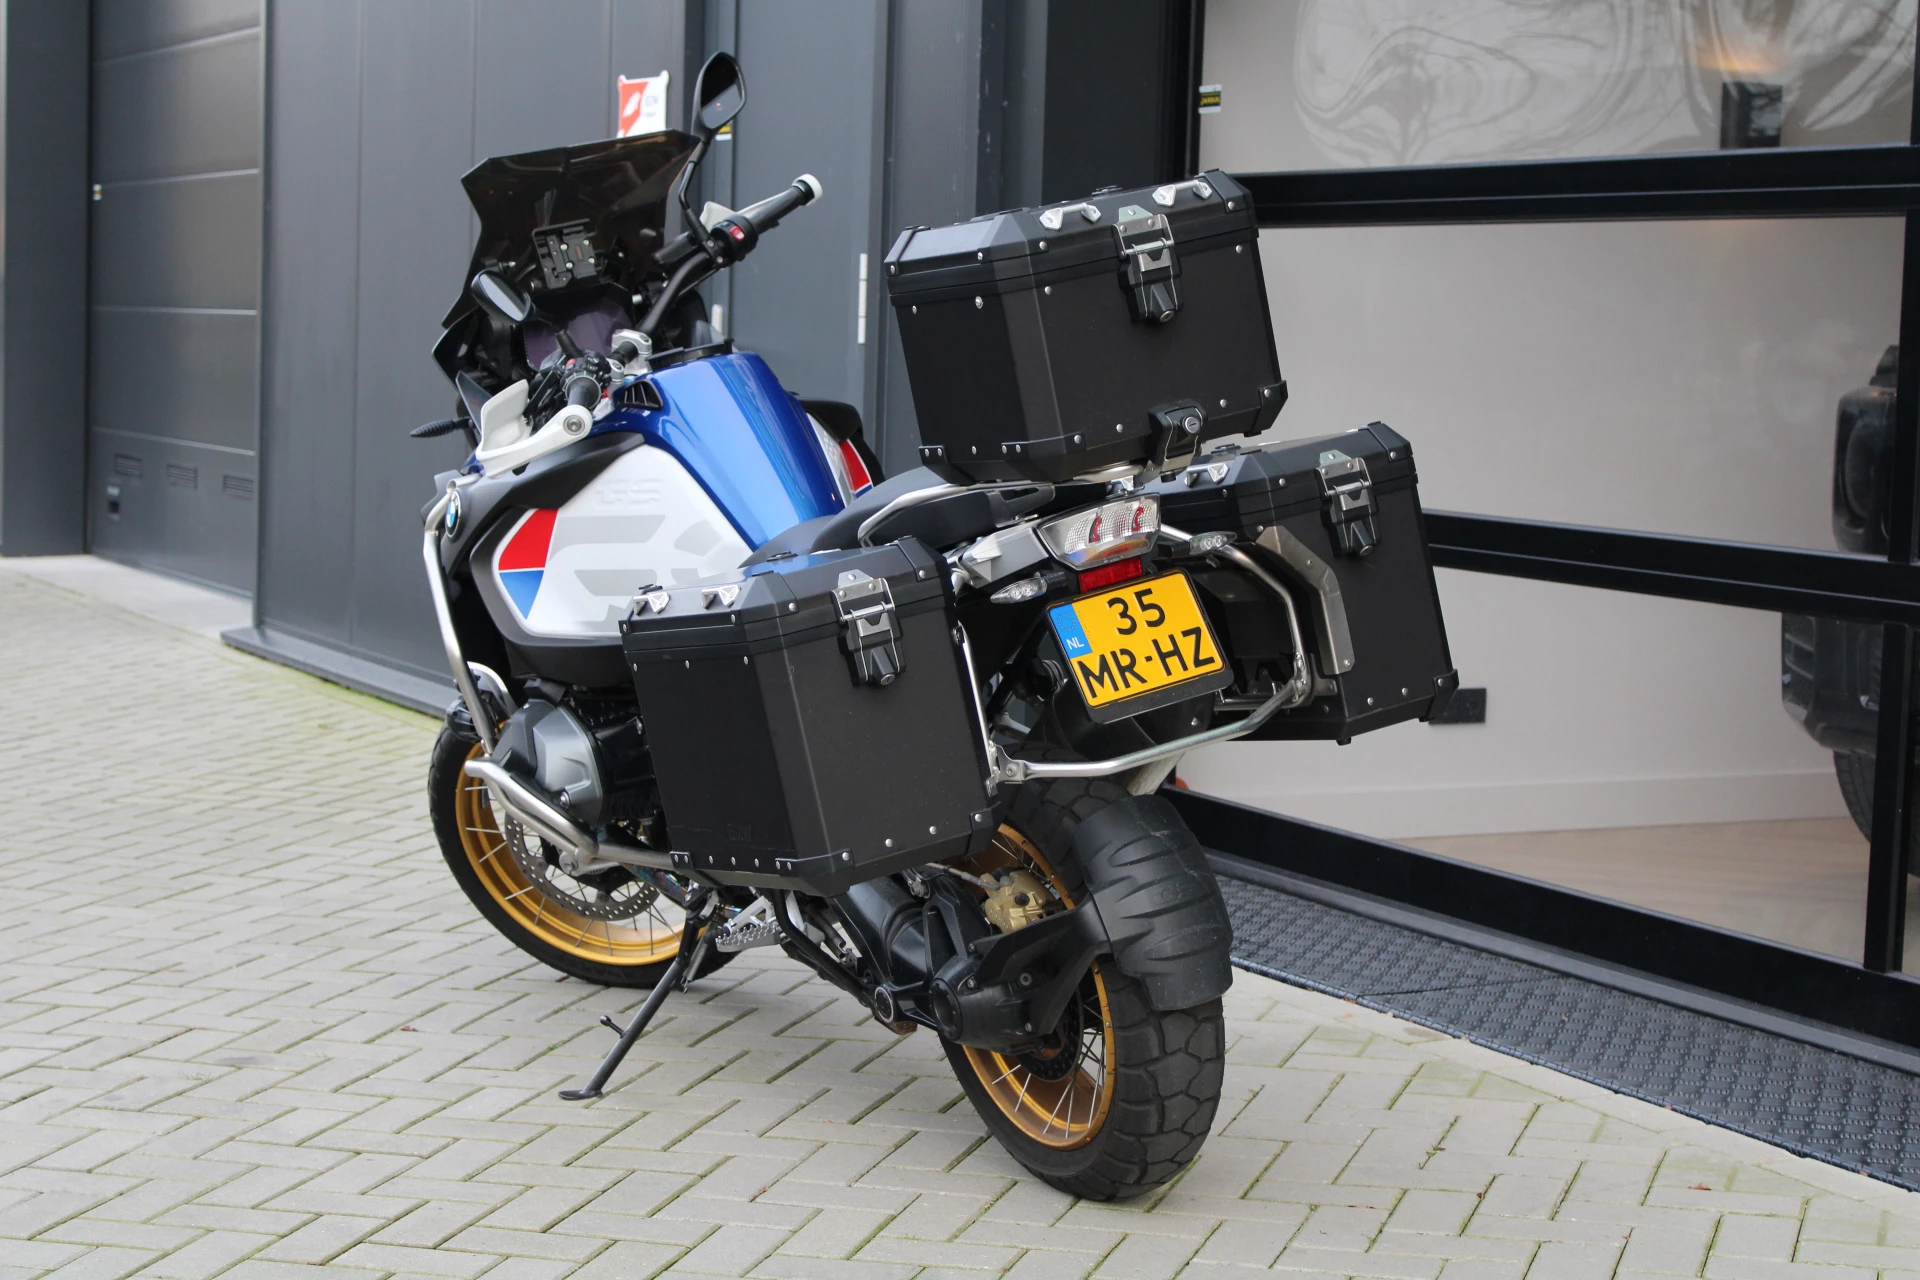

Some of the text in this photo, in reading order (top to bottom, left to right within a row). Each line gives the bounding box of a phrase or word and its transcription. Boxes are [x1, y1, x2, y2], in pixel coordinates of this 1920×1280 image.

[1107, 588, 1165, 635] 35
[1066, 637, 1084, 650] NL
[1078, 627, 1215, 698] MR-HZ
